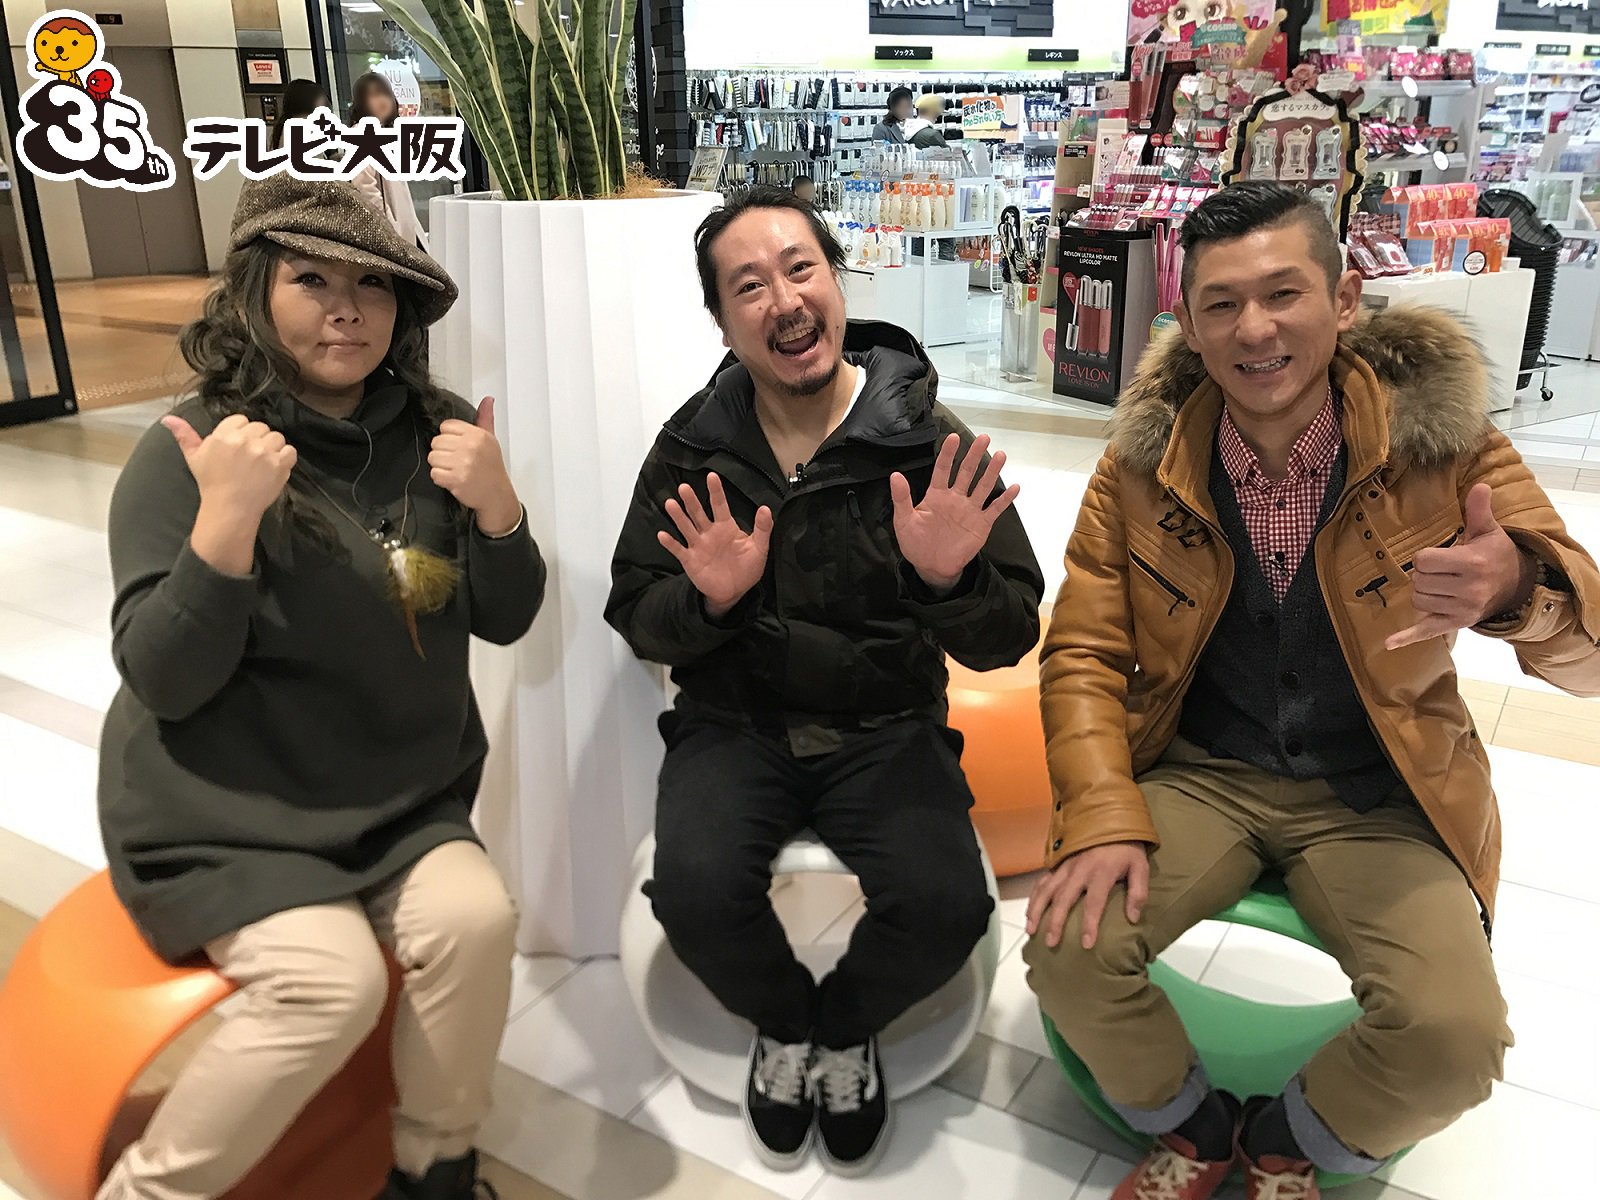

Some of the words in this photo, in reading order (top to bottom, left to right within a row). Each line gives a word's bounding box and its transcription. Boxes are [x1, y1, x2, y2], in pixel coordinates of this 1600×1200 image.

[1079, 258, 1099, 266] LIPCOLOR
[1058, 361, 1111, 384] REVLON
[1067, 377, 1083, 386] LOVE
